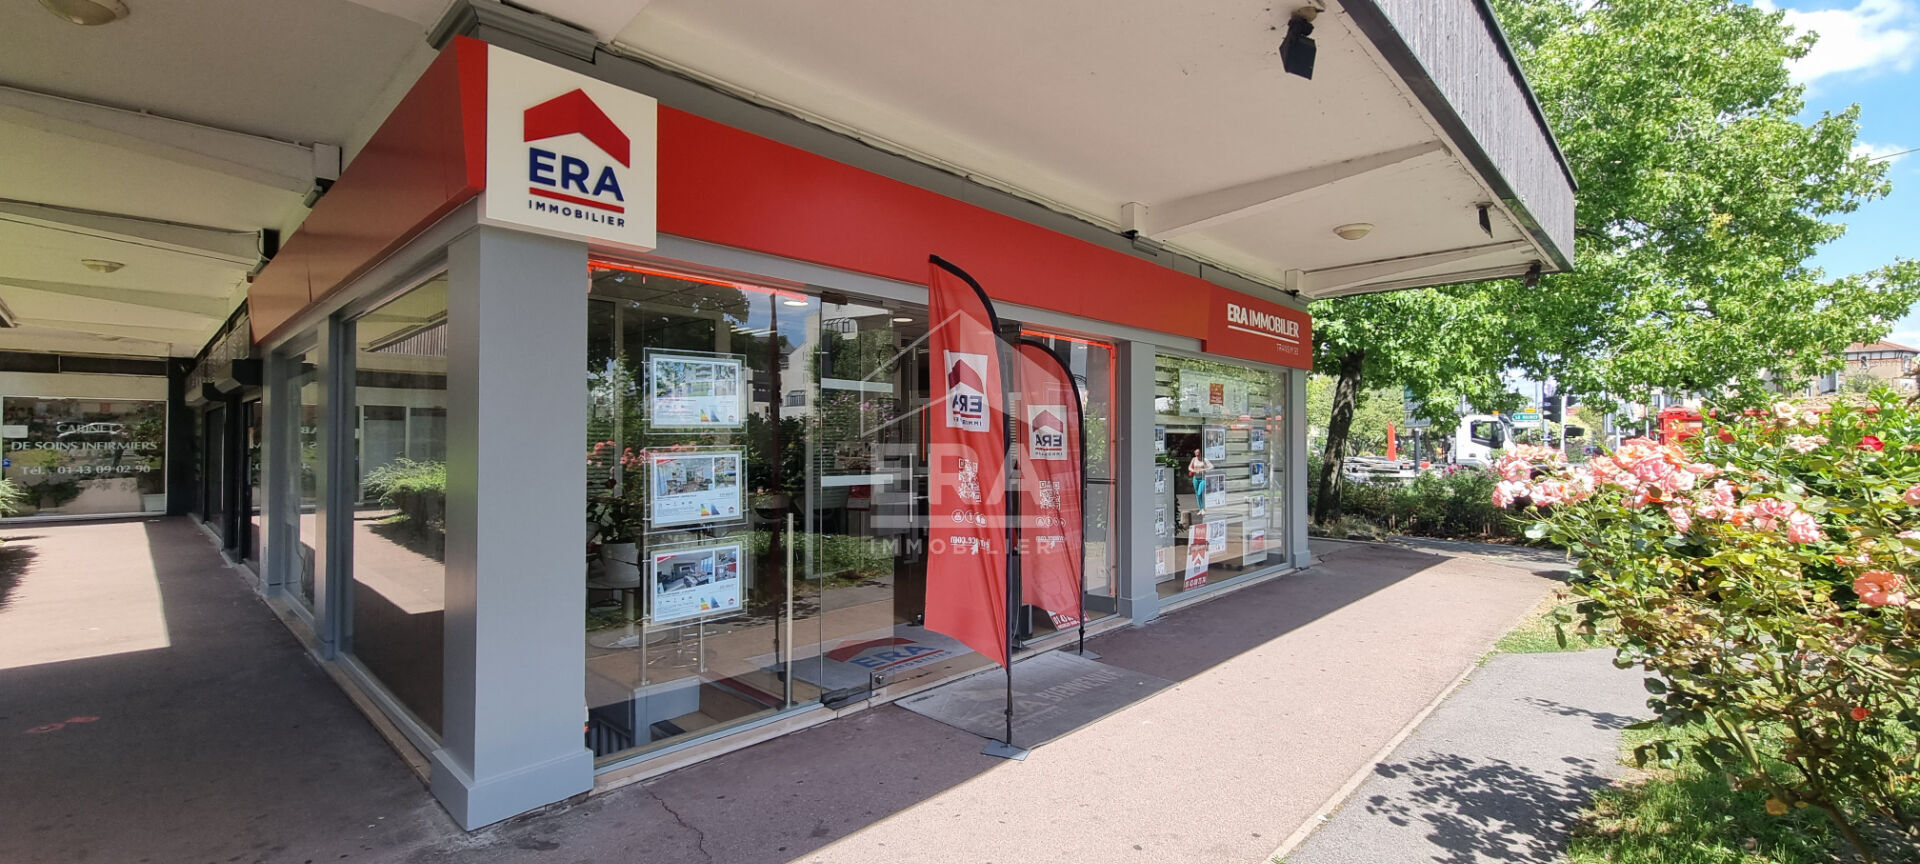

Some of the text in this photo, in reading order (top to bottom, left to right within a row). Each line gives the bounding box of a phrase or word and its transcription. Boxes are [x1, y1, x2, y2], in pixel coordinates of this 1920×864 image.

[529, 147, 625, 202] ERA
[528, 199, 626, 228] IMMOBILIER
[1227, 303, 1300, 338] ERA IMMOBILIER
[56, 424, 116, 434] CABINET
[11, 440, 158, 451] DE SOINS INFIRMIERS
[849, 645, 937, 669] ERA
[1034, 668, 1122, 703] BIENVENUE
